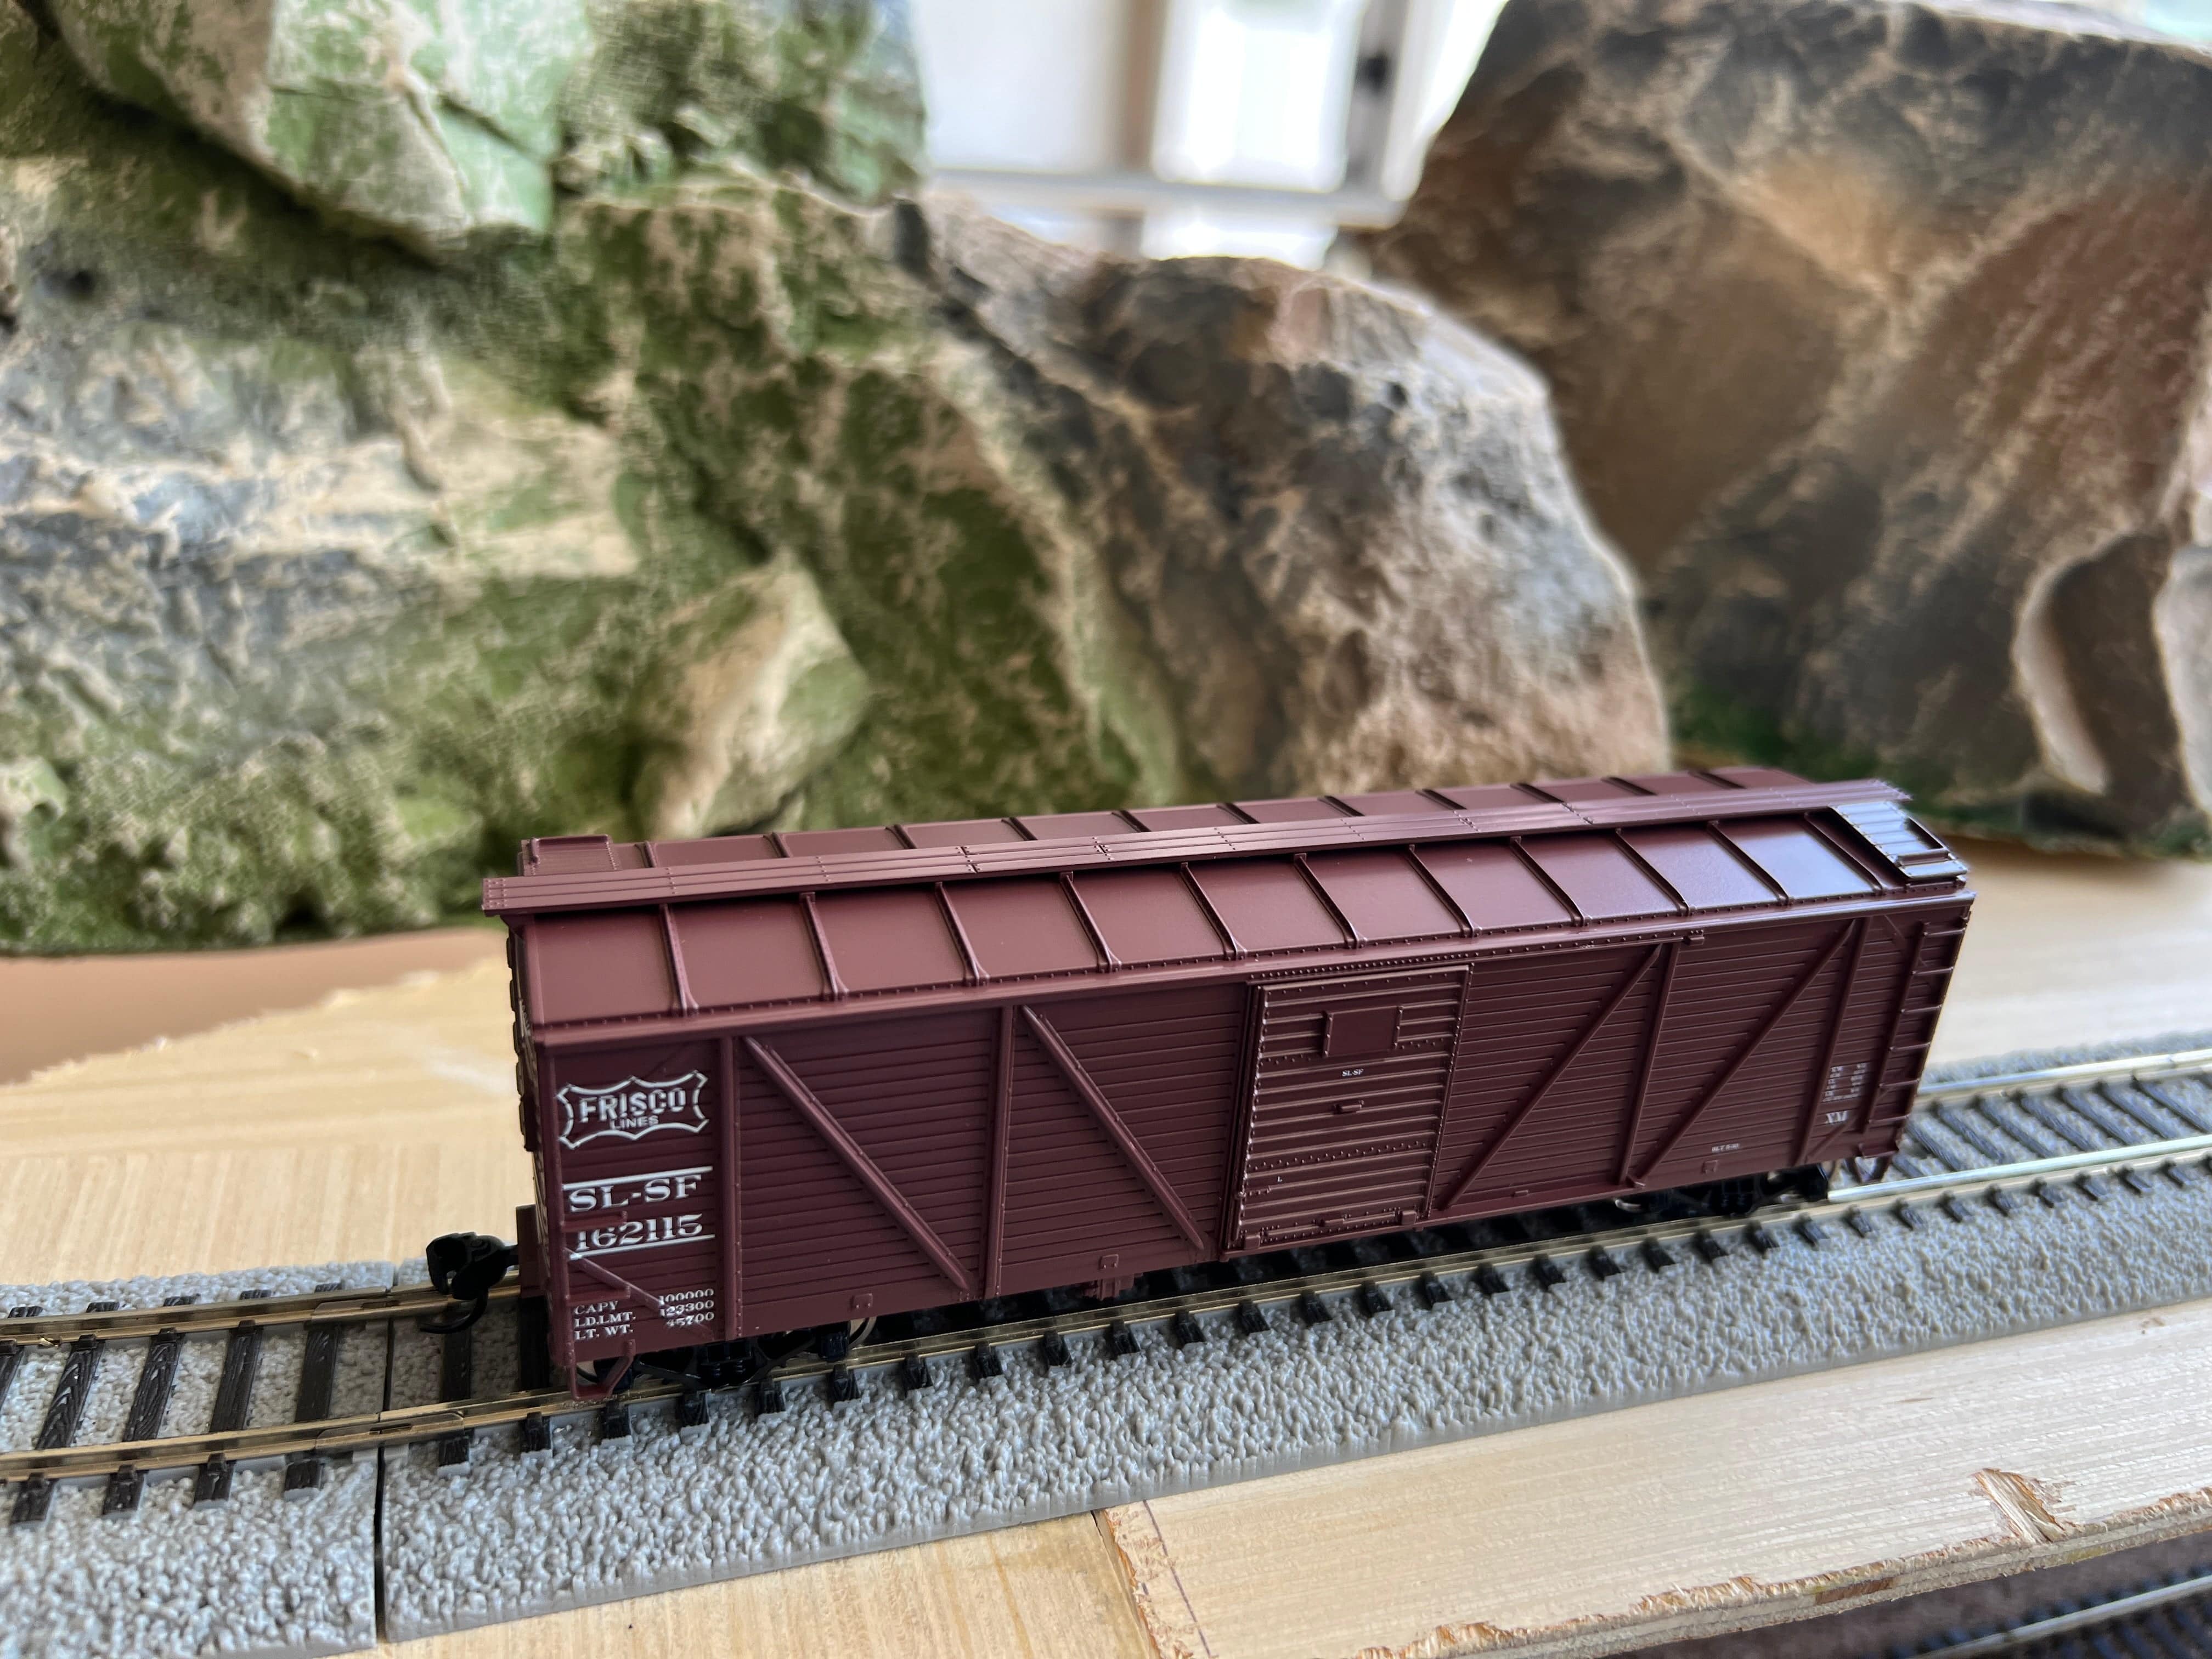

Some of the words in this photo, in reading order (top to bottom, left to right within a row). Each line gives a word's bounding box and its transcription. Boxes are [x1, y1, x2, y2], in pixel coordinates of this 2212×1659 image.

[579, 1087, 686, 1122] FRISCO
[610, 1115, 659, 1130] LINES
[569, 1175, 702, 1213] SL-SF
[576, 1214, 703, 1251] 162115
[574, 1300, 618, 1315] CAPY
[658, 1288, 714, 1306] 100000
[660, 1300, 714, 1317] 123300
[574, 1328, 600, 1340] LT.
[604, 1324, 633, 1336] WT.
[666, 1312, 714, 1327] 45700
